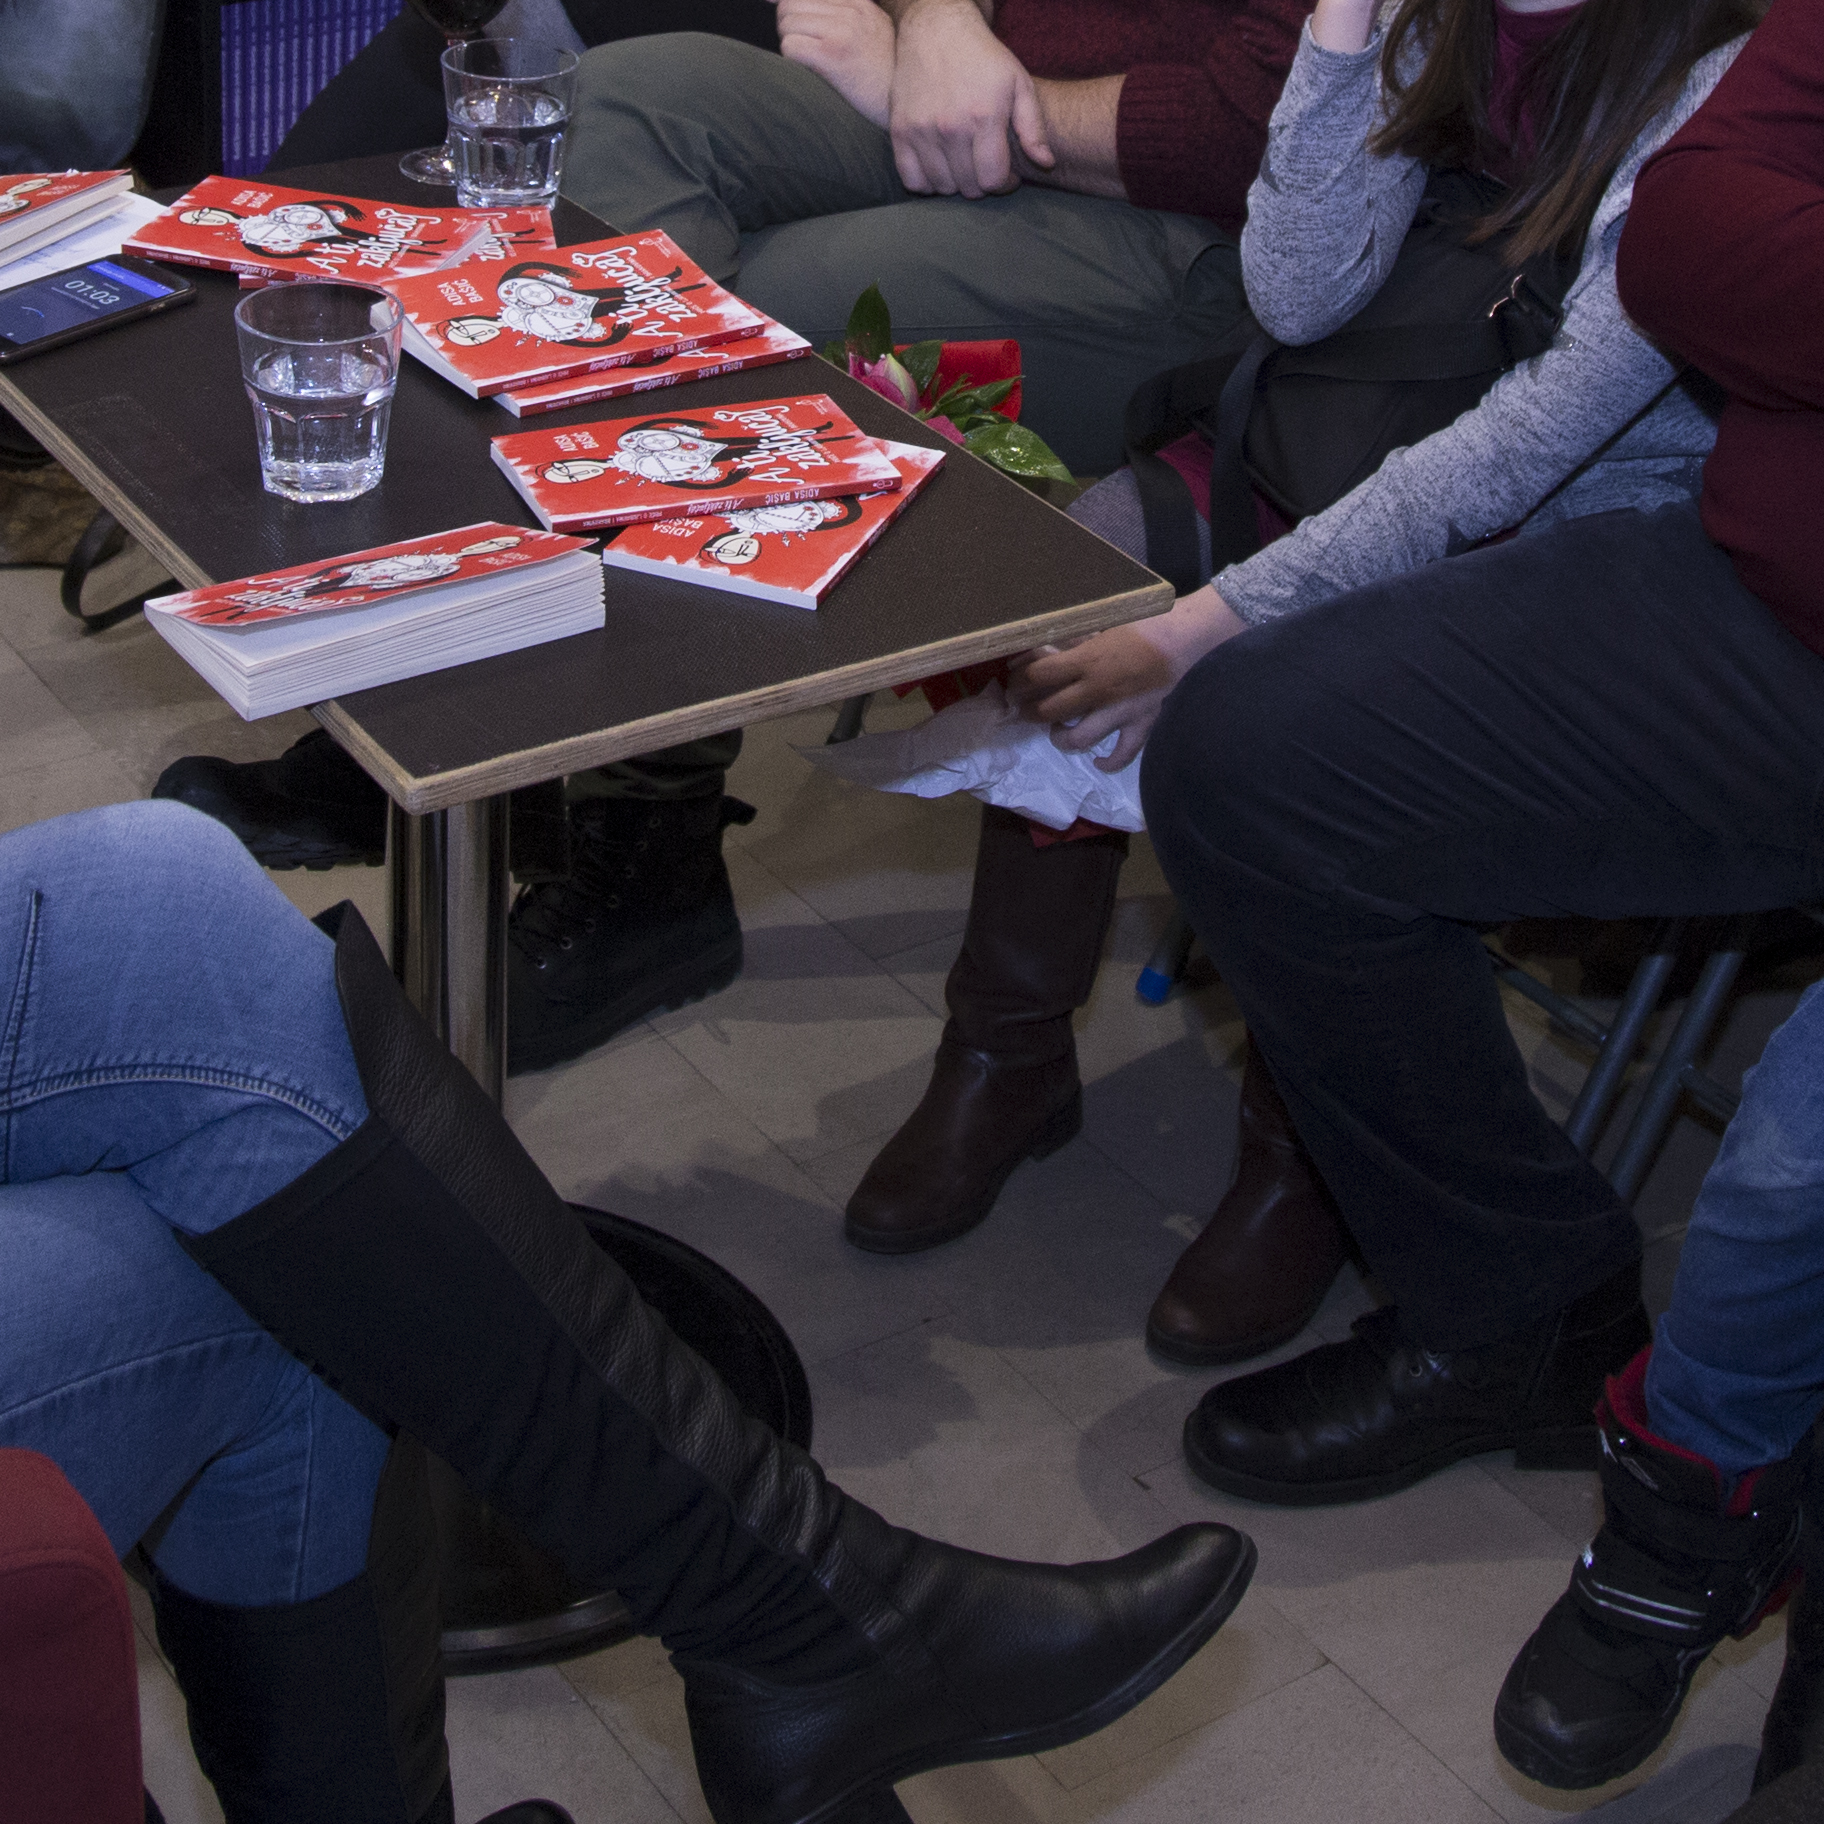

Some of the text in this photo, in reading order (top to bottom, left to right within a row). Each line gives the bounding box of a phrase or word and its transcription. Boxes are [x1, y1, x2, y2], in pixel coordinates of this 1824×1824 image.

[64, 278, 120, 307] 01:03
[436, 281, 467, 307] ADISA
[452, 278, 484, 304] BAŠIĆ
[552, 433, 581, 453] ADISA
[764, 491, 792, 505] BAŠIĆ
[794, 487, 820, 501] ADISA
[651, 522, 696, 538] ADISA
